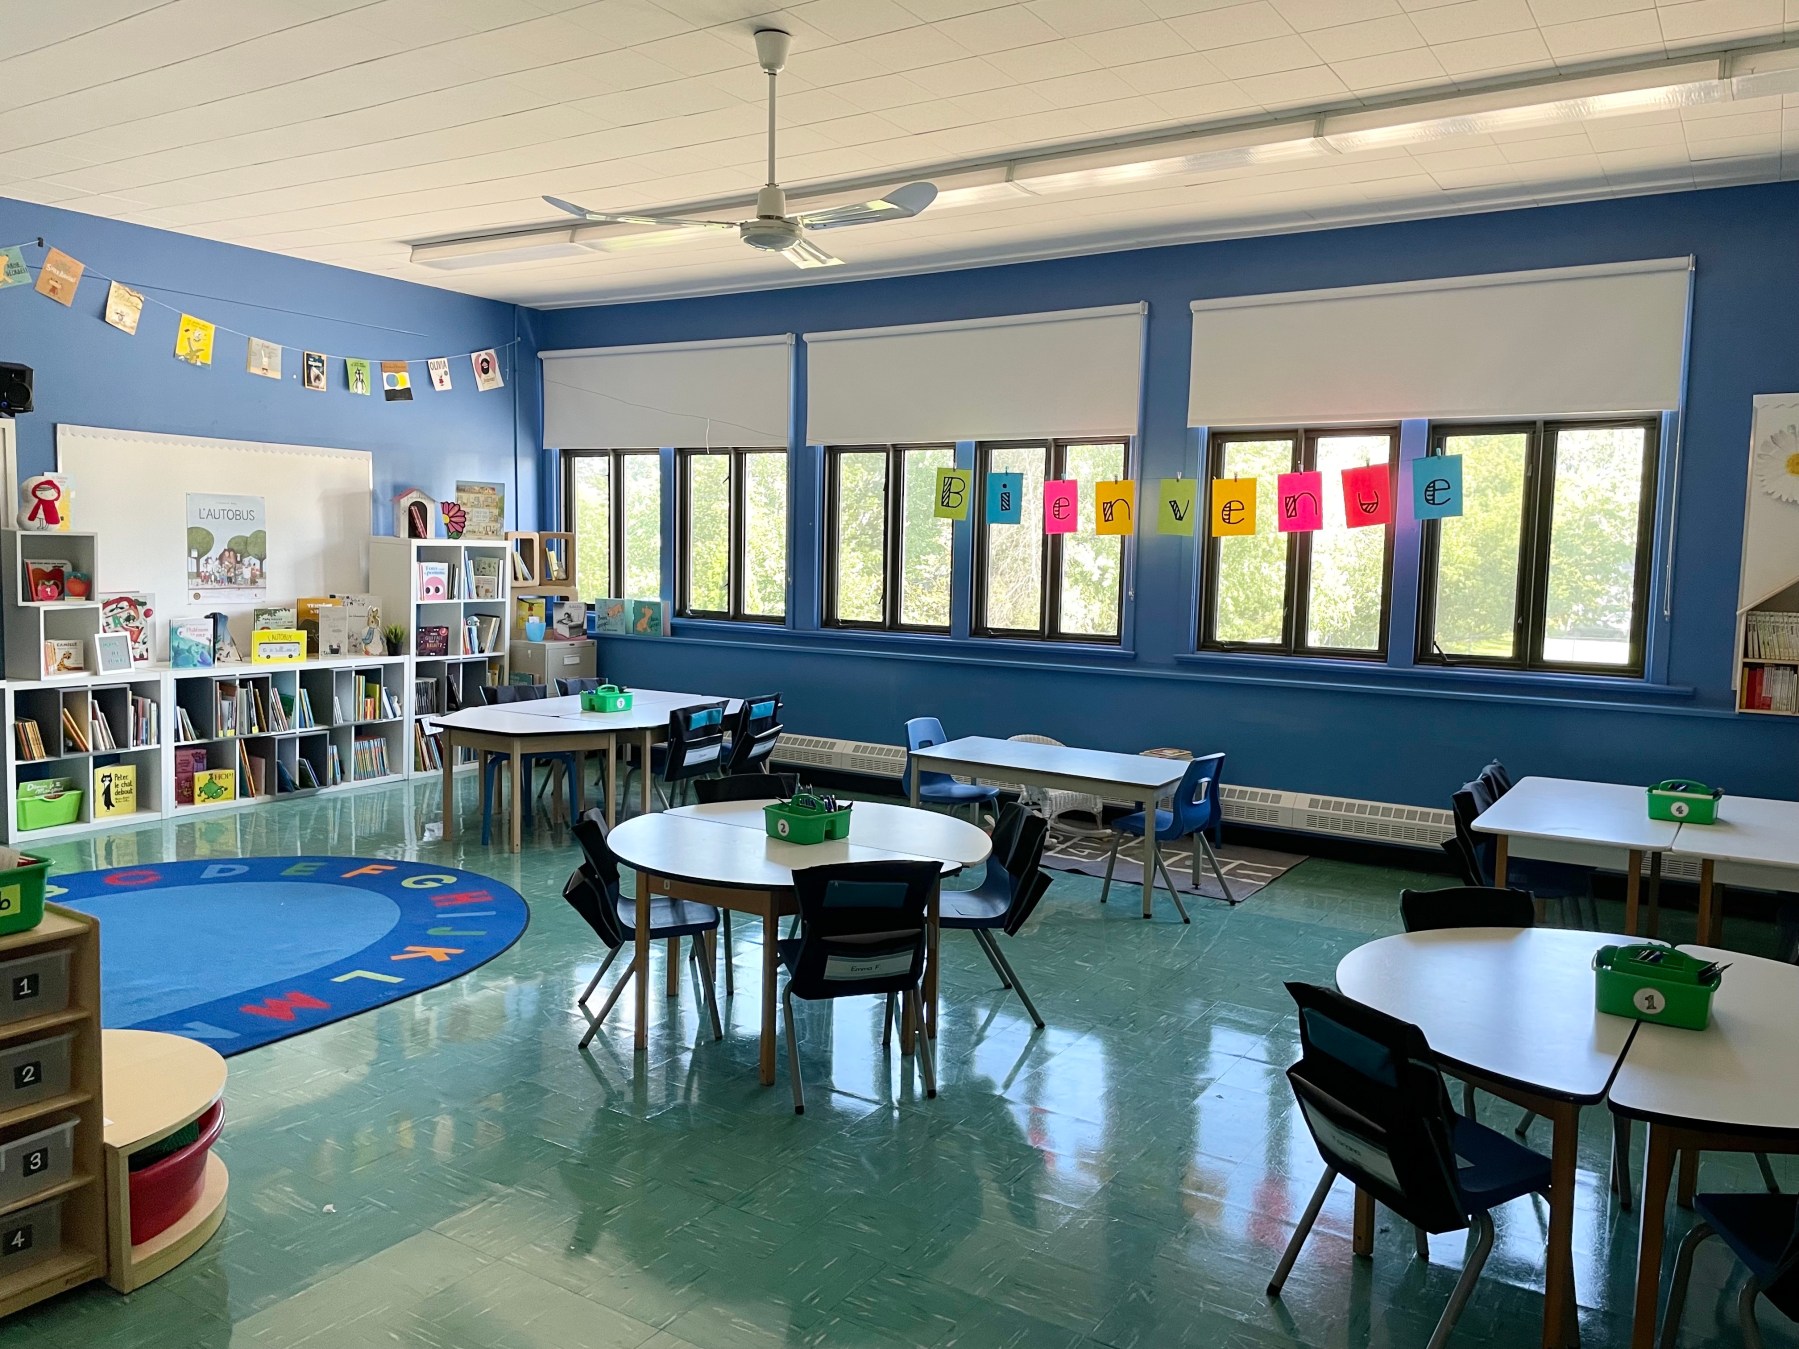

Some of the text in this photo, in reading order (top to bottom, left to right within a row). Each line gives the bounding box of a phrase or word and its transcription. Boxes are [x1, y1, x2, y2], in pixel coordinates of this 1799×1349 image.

[198, 507, 255, 521] L'AUTOBUS
[114, 773, 128, 781] Peter
[121, 780, 133, 788] chat
[114, 788, 133, 796] debout
[1675, 804, 1684, 815] 4
[779, 823, 787, 834] 2
[200, 864, 249, 879] D
[280, 862, 329, 876] E
[340, 864, 398, 878] F
[401, 874, 458, 889] G
[429, 890, 494, 908] H
[426, 926, 488, 936] J
[390, 945, 465, 962] K
[330, 970, 406, 984] L
[19, 978, 32, 995] 1
[239, 990, 332, 1021] M
[1645, 994, 1657, 1010] 1
[21, 1065, 35, 1083] 2
[30, 1152, 41, 1170] 3
[11, 1230, 25, 1248] 4
